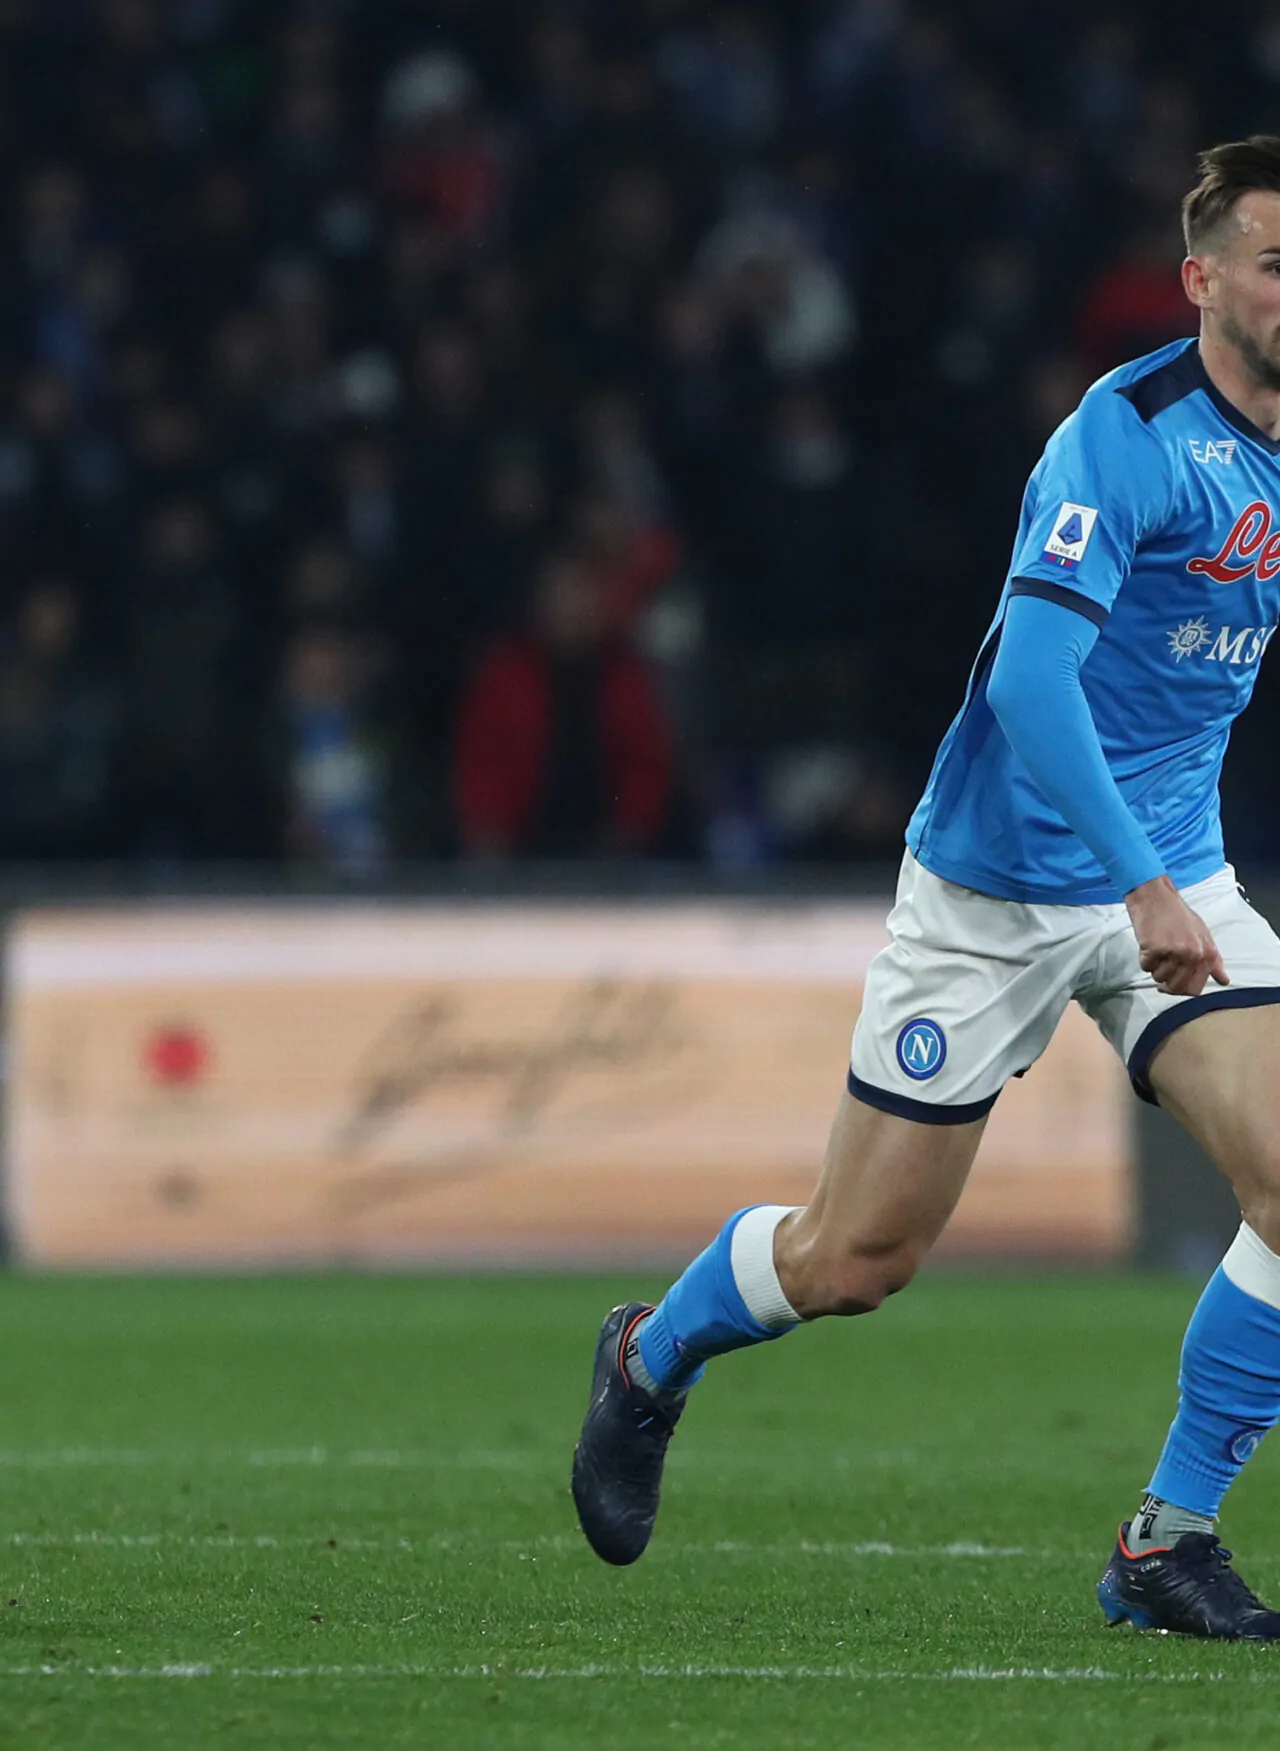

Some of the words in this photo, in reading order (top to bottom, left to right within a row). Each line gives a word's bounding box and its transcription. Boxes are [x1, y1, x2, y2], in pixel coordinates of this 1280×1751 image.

[1189, 439, 1237, 464] EA7
[1050, 544, 1072, 556] SERIE
[1071, 550, 1078, 558] A
[908, 1033, 935, 1065] N
[1140, 1559, 1162, 1573] COPA
